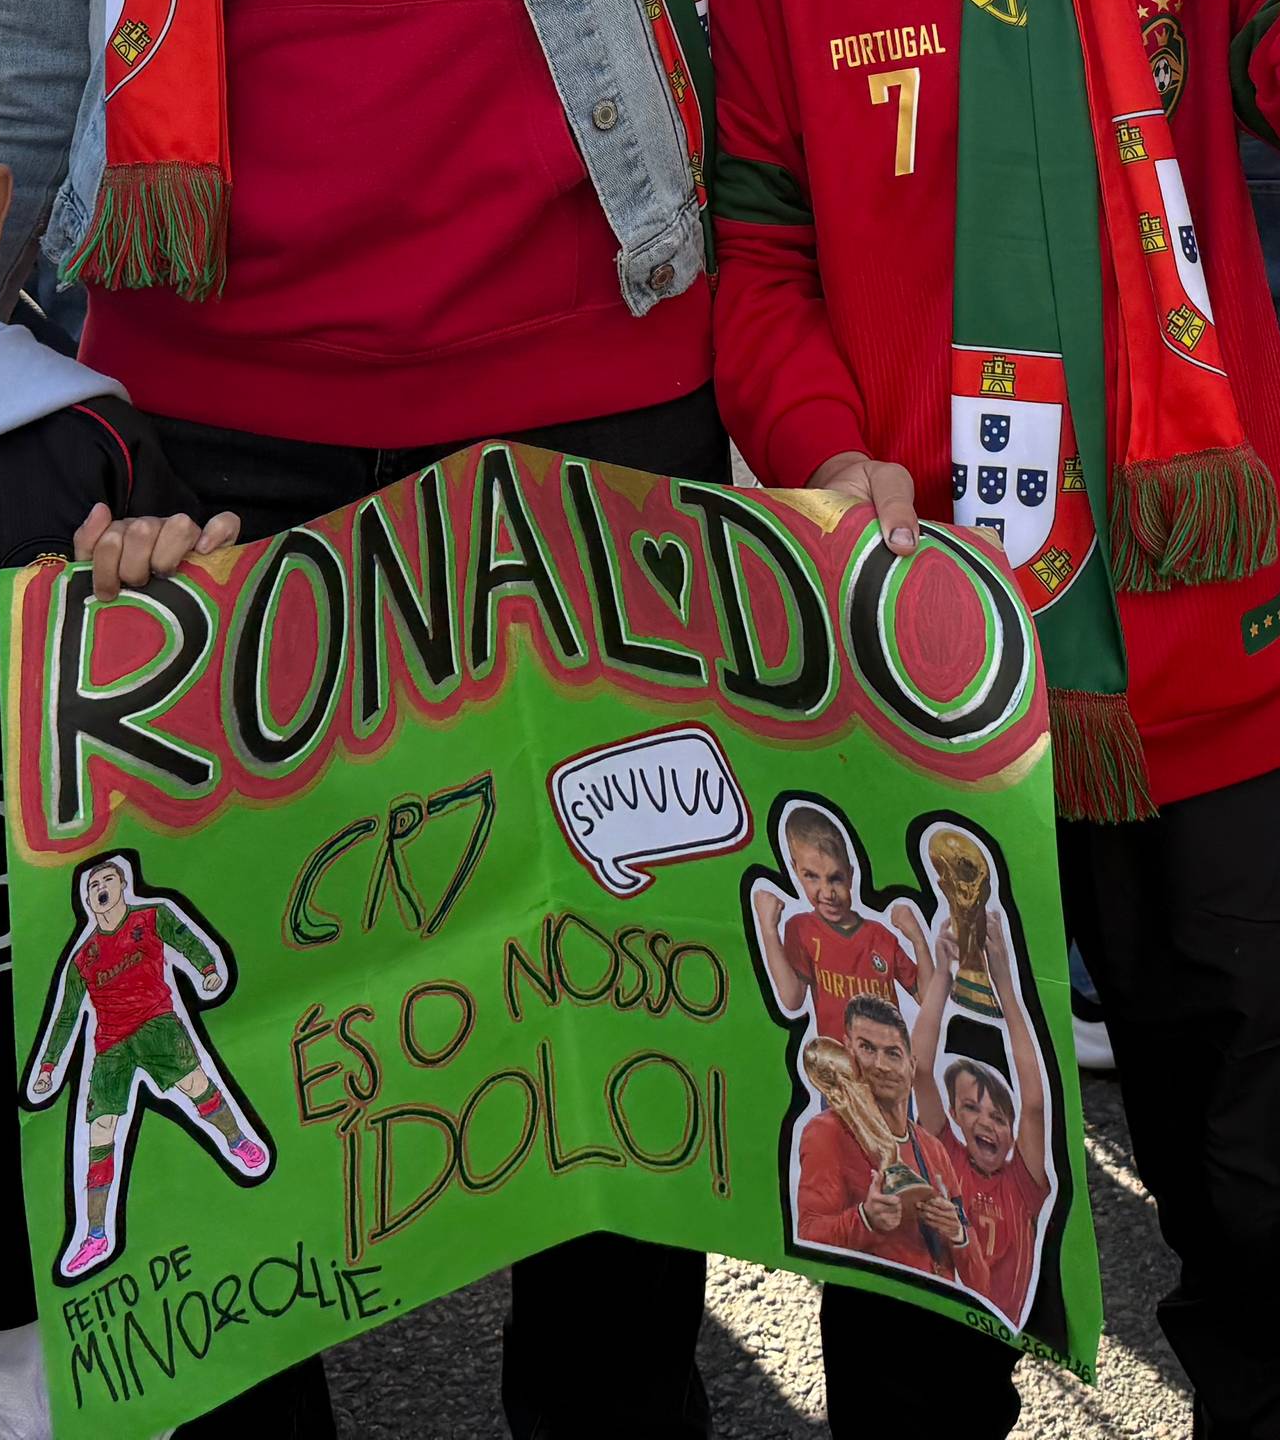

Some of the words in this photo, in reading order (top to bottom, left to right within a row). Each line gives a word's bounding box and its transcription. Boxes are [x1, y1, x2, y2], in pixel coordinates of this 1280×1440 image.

[830, 23, 946, 70] PORTUGAL
[868, 67, 920, 176] 7
[48, 444, 1030, 830] RONALDO
[284, 770, 495, 948] CR7
[291, 1004, 381, 1126] ÉS
[401, 980, 475, 1067] O
[505, 912, 728, 1022] NOSSO
[149, 1245, 192, 1291] DE
[966, 1311, 1011, 1342] OSLO
